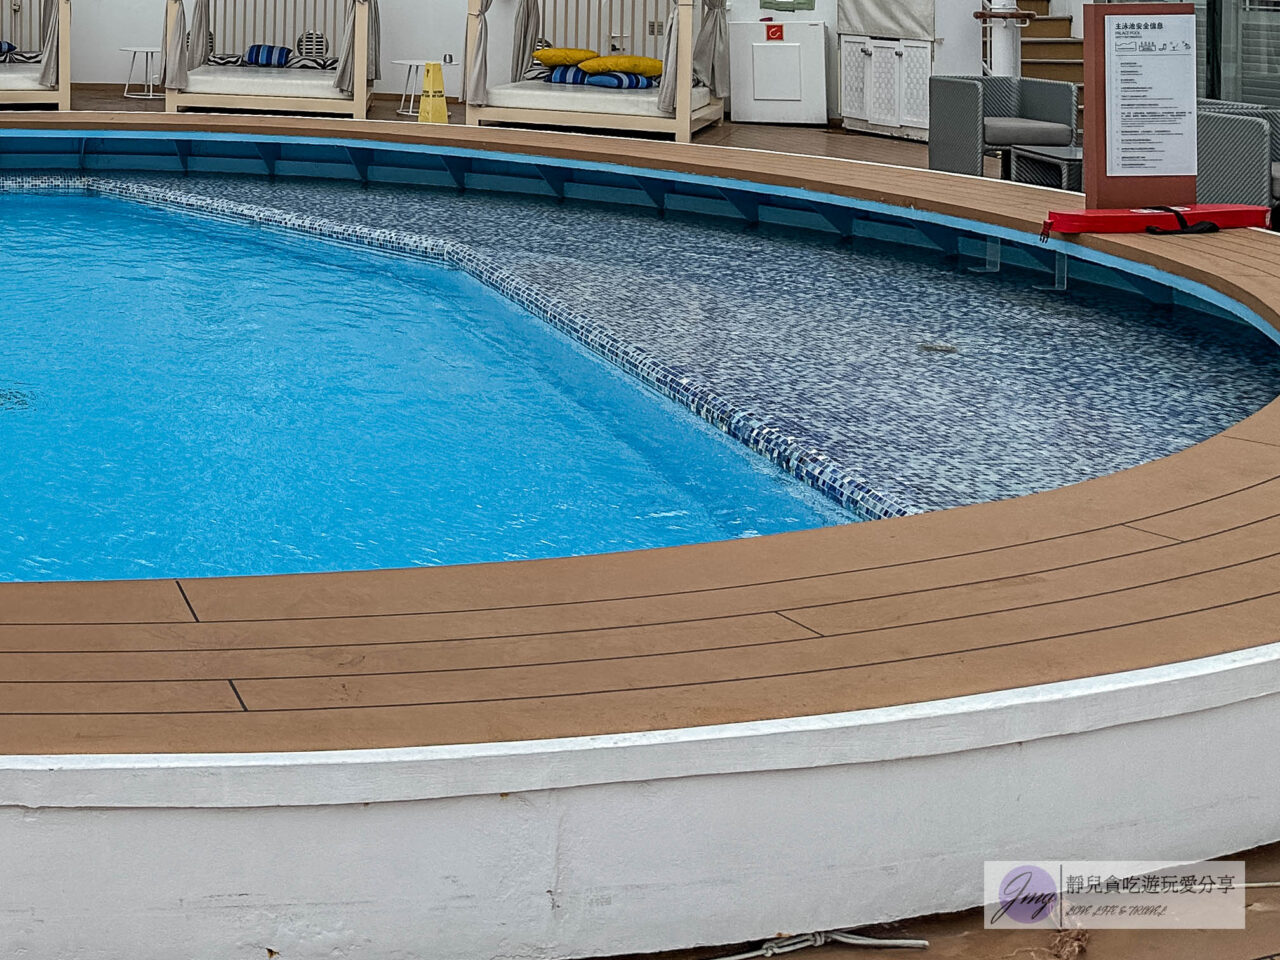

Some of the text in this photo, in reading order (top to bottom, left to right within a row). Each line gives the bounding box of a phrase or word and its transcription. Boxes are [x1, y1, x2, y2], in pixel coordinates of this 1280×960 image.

[1115, 22, 1163, 30] 主泳池安全信息
